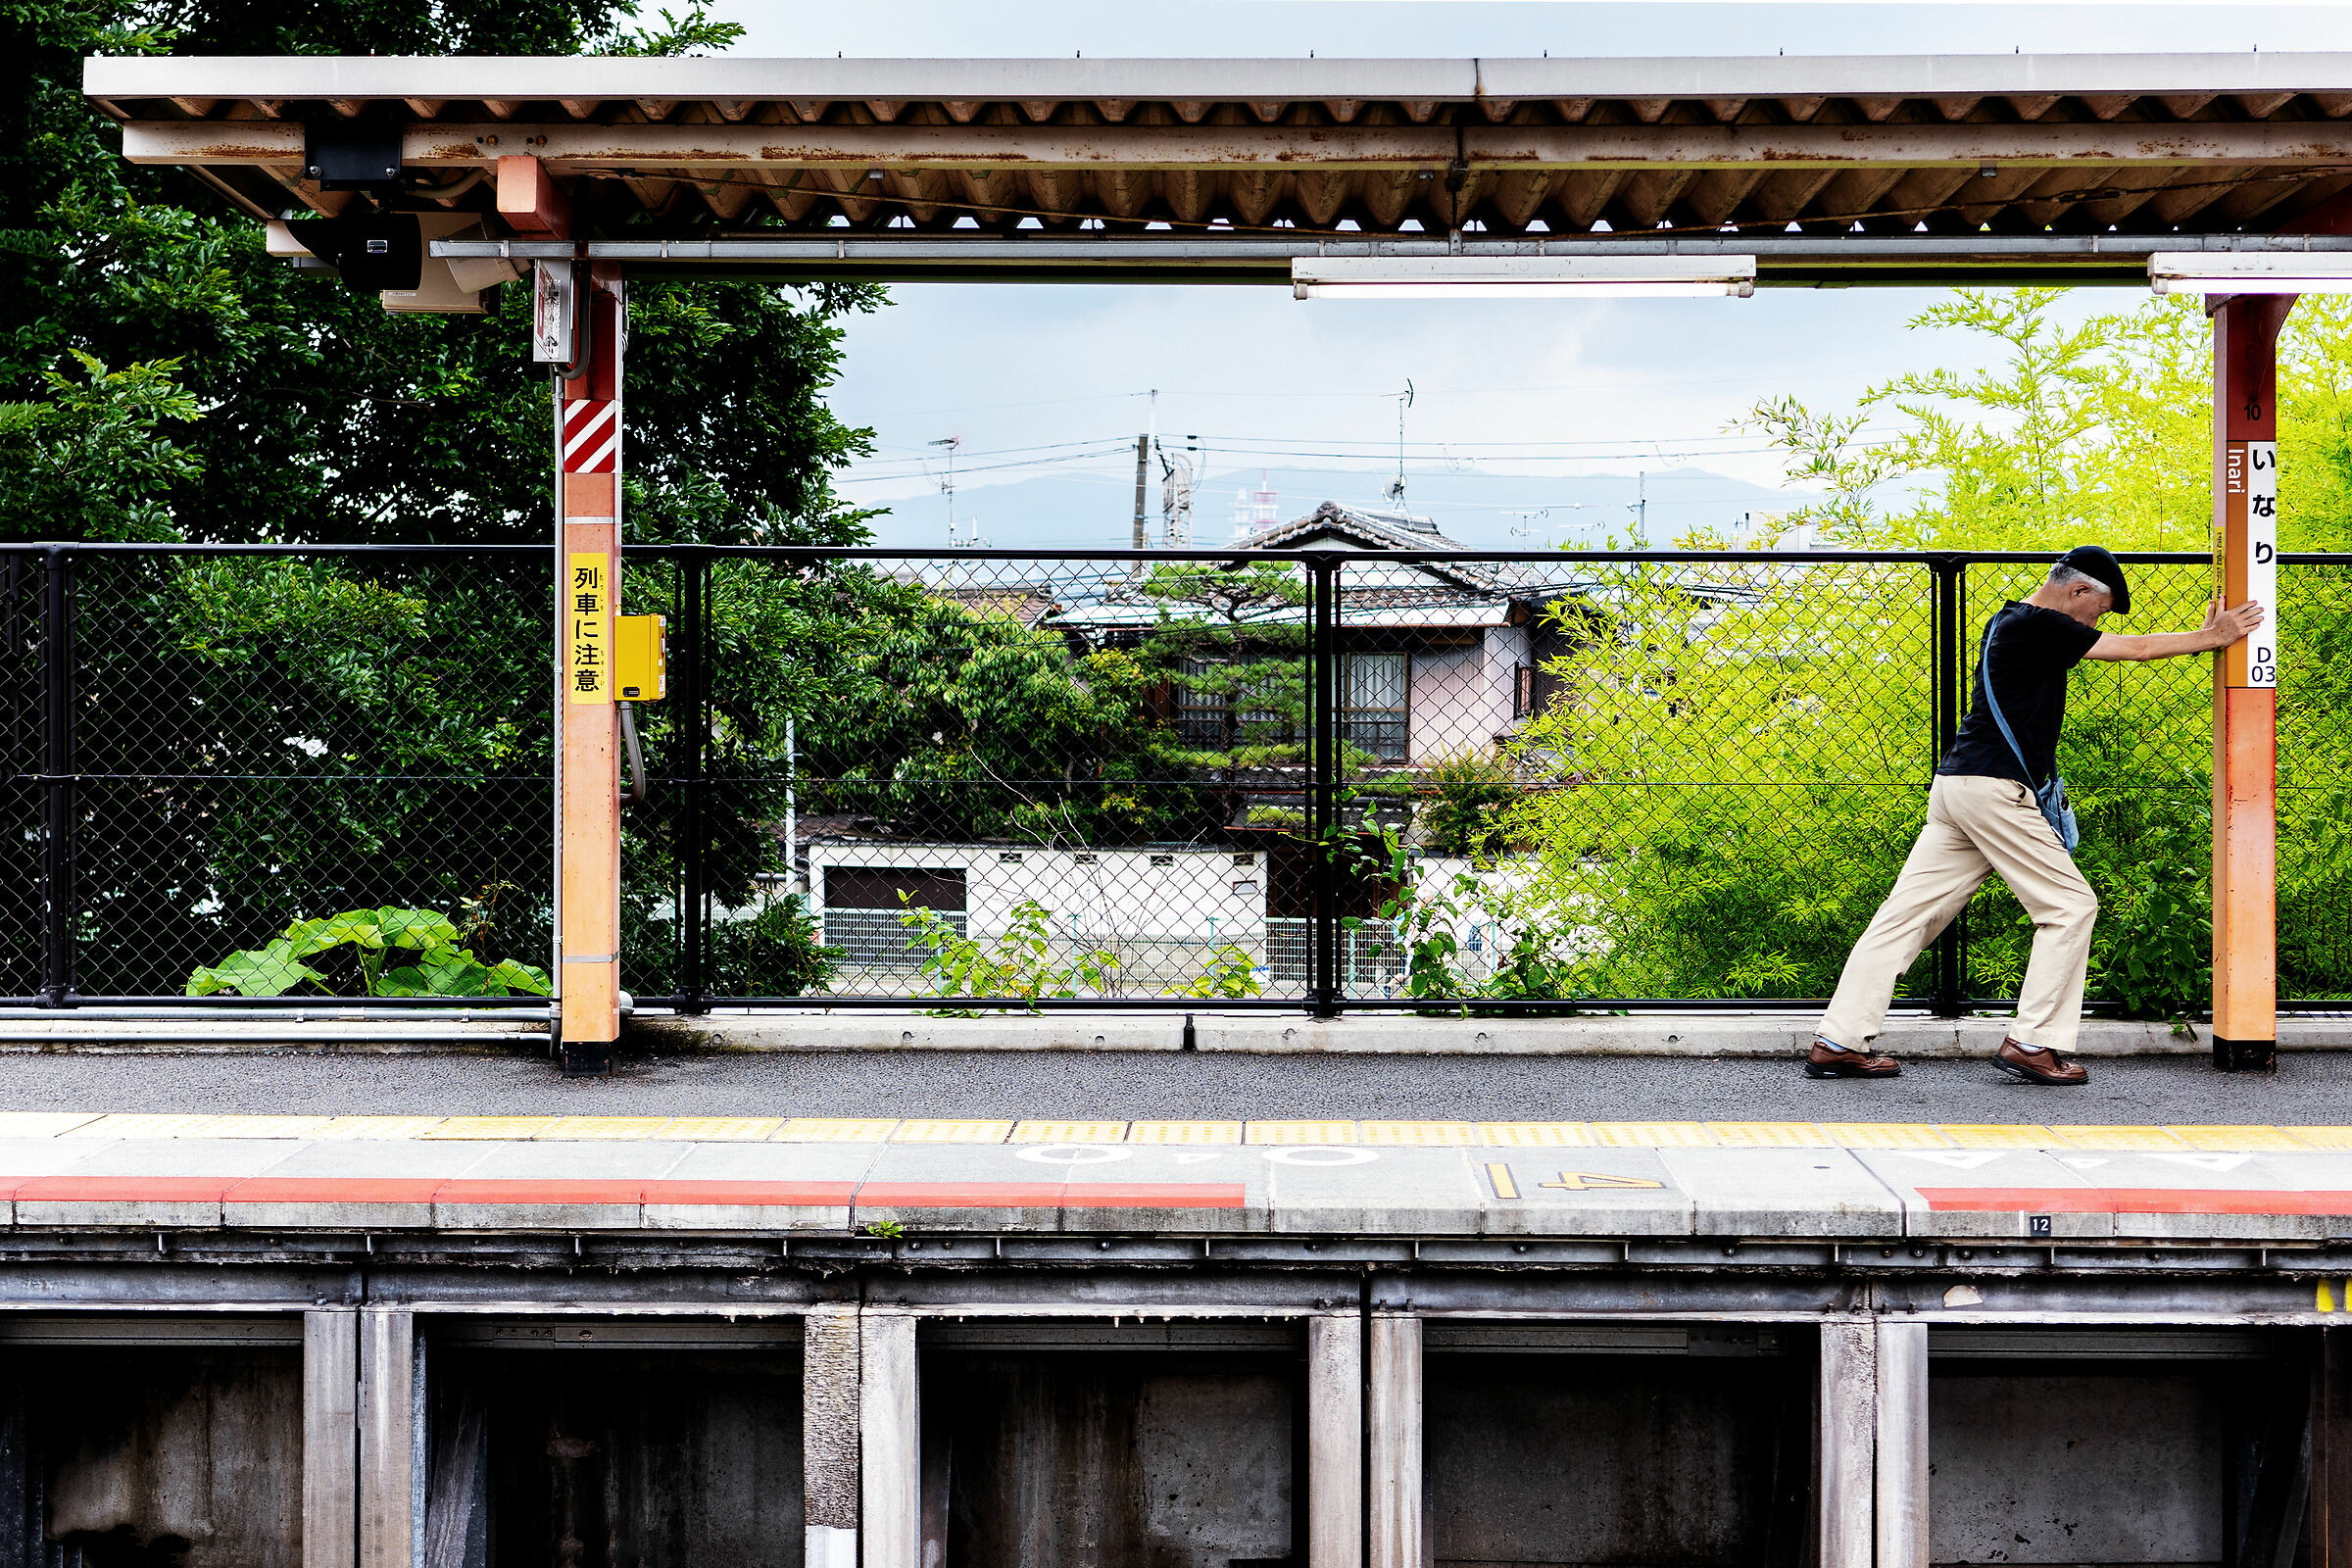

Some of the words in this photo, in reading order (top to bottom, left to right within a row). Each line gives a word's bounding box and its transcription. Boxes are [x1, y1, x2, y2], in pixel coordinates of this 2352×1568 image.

[2244, 404, 2261, 420] 10
[2228, 449, 2245, 493] Inari
[2252, 449, 2276, 564] いなり
[574, 566, 600, 692] 列車に注意
[2258, 647, 2272, 662] D
[2251, 665, 2276, 682] 03
[2033, 1218, 2049, 1231] 12
